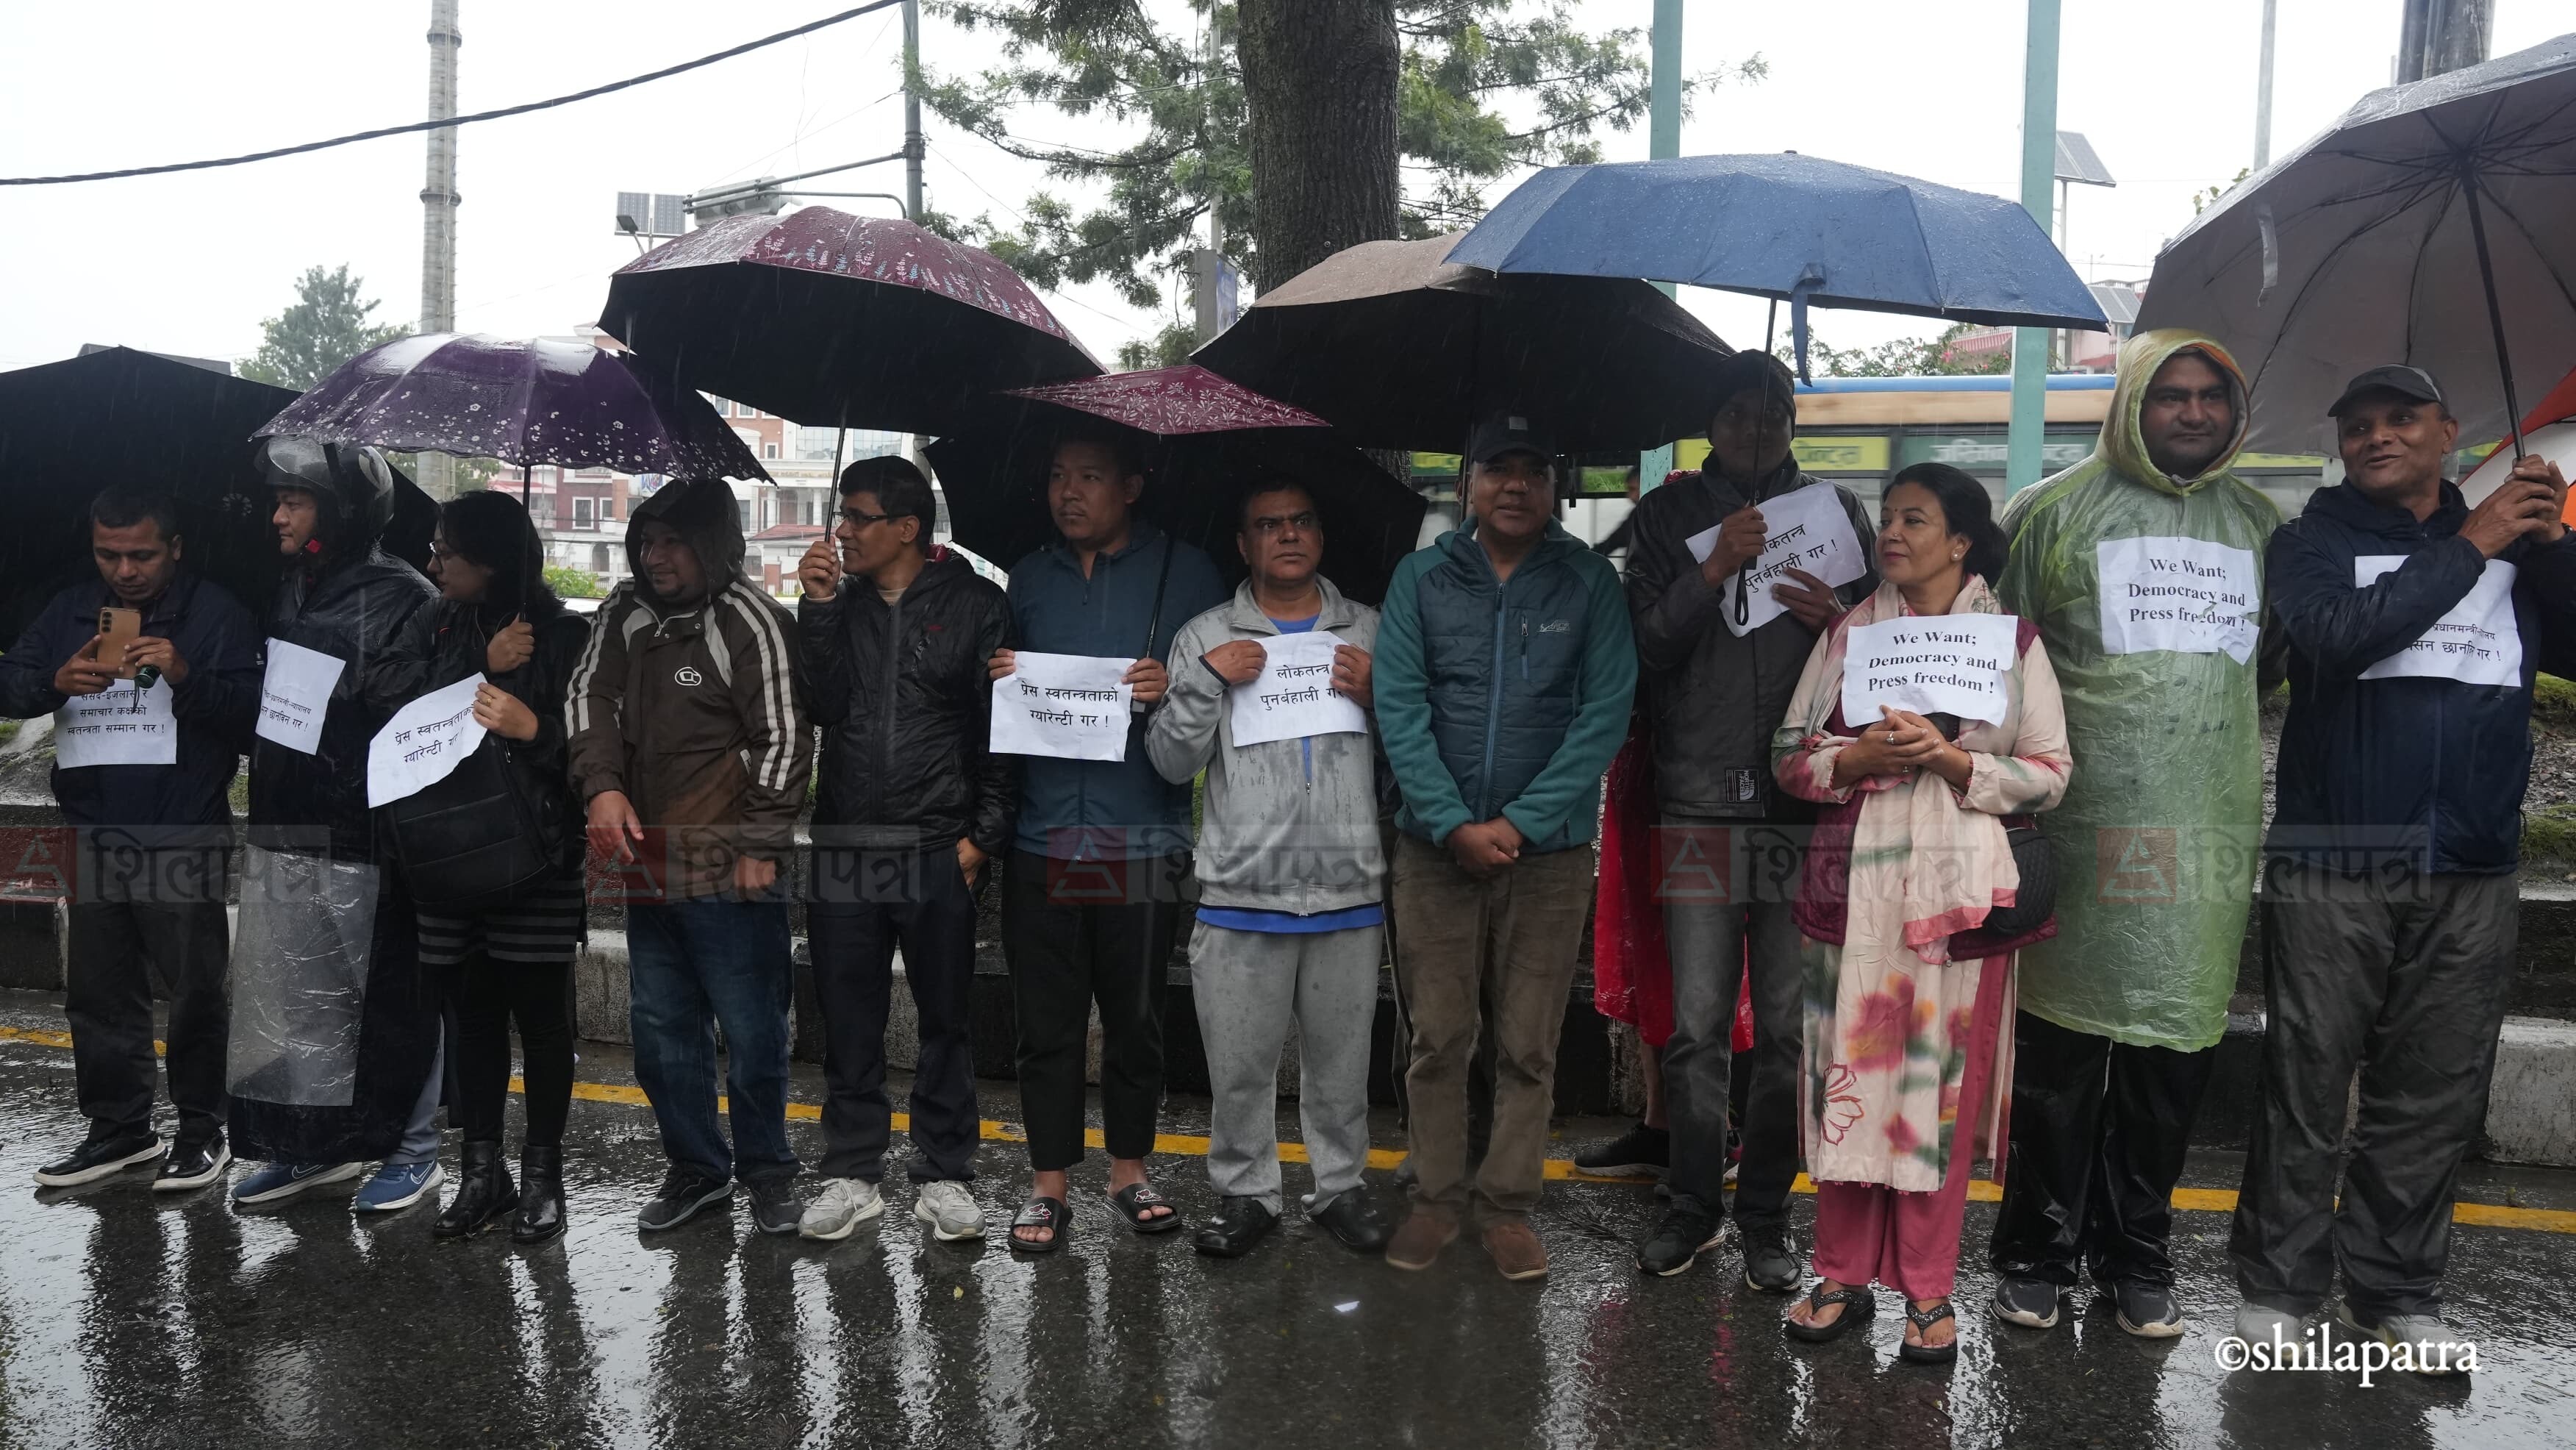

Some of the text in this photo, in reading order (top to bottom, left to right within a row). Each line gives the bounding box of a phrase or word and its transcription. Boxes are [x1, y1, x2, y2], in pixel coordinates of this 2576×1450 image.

[1806, 544, 1827, 560] गर
[2150, 559, 2226, 581] We Want;
[2129, 583, 2245, 607] Democracy and
[2129, 608, 2173, 622] Press
[1893, 631, 1977, 647] We Want;
[1869, 652, 1997, 671] Democracy and
[2477, 648, 2491, 661] गर
[1276, 663, 1330, 679] लोकतन्त्र
[1868, 673, 1908, 691] Press
[1914, 671, 1983, 692] freedom
[1020, 680, 1118, 702] प्रेस स्वतन्त्रताको
[79, 708, 113, 718] समाचार
[1029, 709, 1073, 726] ग्यारेन्टी
[1080, 715, 1098, 727] गर
[66, 725, 101, 735] स्वतन्त्रता
[106, 724, 137, 734] सम्मान
[143, 724, 157, 733] गर
[293, 718, 304, 729] गर
[395, 730, 411, 746] प्रेस
[404, 740, 443, 763] ग्यारेन्टी
